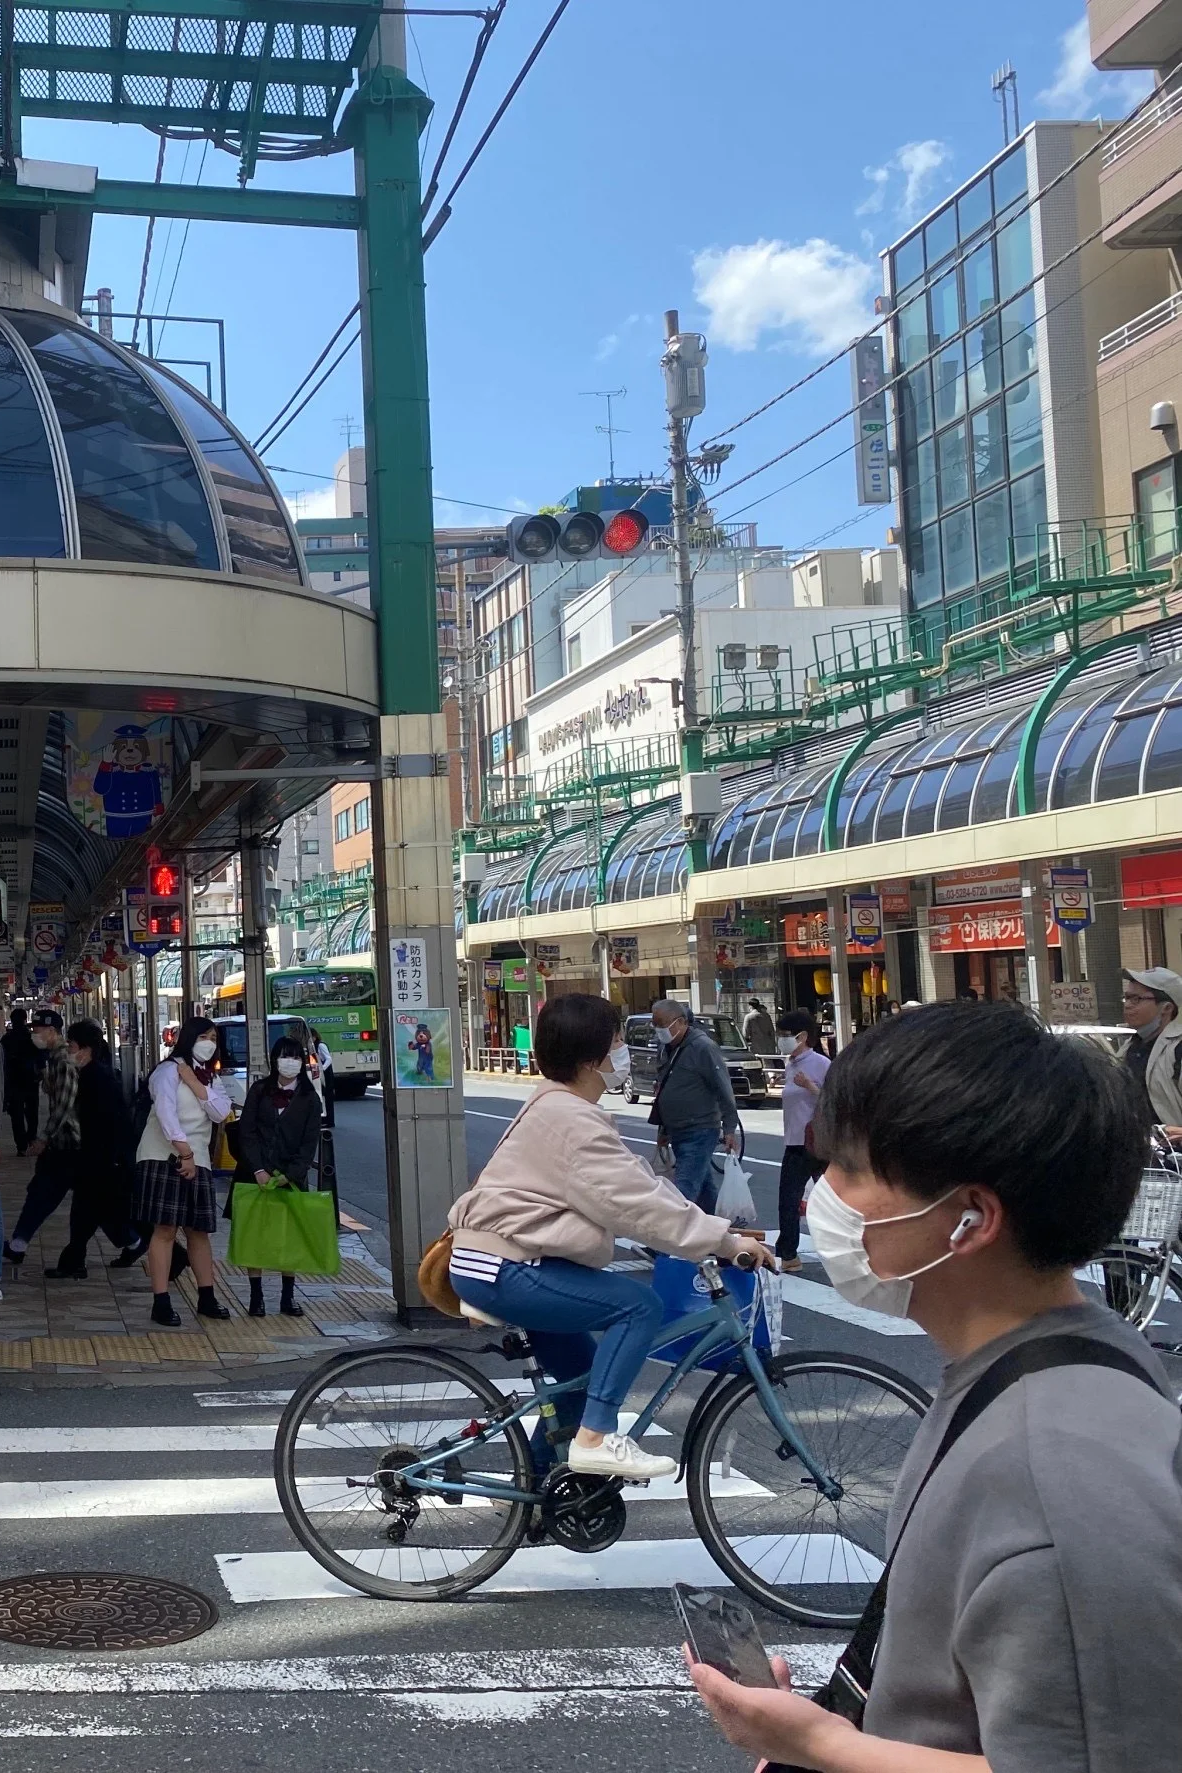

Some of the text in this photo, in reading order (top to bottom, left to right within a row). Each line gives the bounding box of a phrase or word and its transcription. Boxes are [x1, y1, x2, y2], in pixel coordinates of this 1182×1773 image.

[397, 968, 409, 1002] 作動中
[410, 945, 423, 1002] 防犯カメラ
